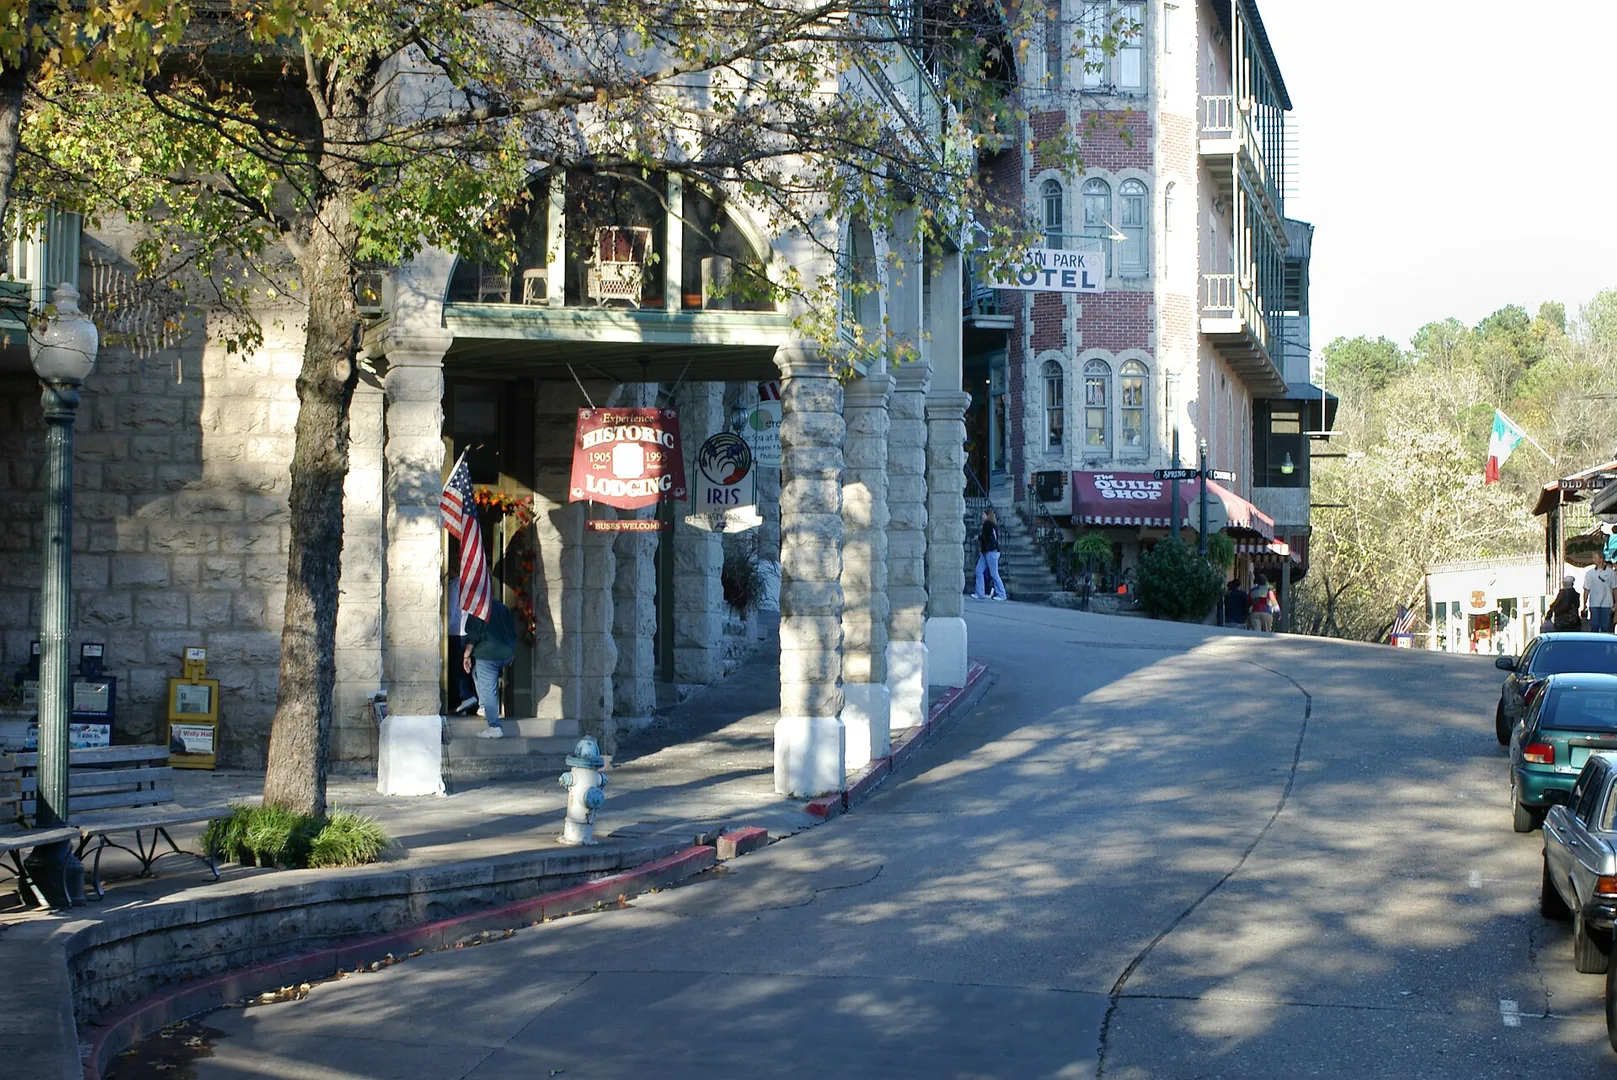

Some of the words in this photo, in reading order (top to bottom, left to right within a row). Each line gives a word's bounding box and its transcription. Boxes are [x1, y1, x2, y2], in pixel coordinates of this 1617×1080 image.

[1053, 253, 1085, 268] PARK
[602, 413, 654, 424] Experience
[582, 425, 674, 450] HISTORIC
[589, 452, 611, 462] 1905
[646, 451, 668, 462] 1995
[1163, 470, 1186, 479] SPRING
[585, 473, 672, 497] LODGING
[1094, 480, 1163, 490] QUILT
[1561, 480, 1582, 489] OLD
[706, 488, 741, 504] IRIS
[1100, 489, 1162, 500] SHOP
